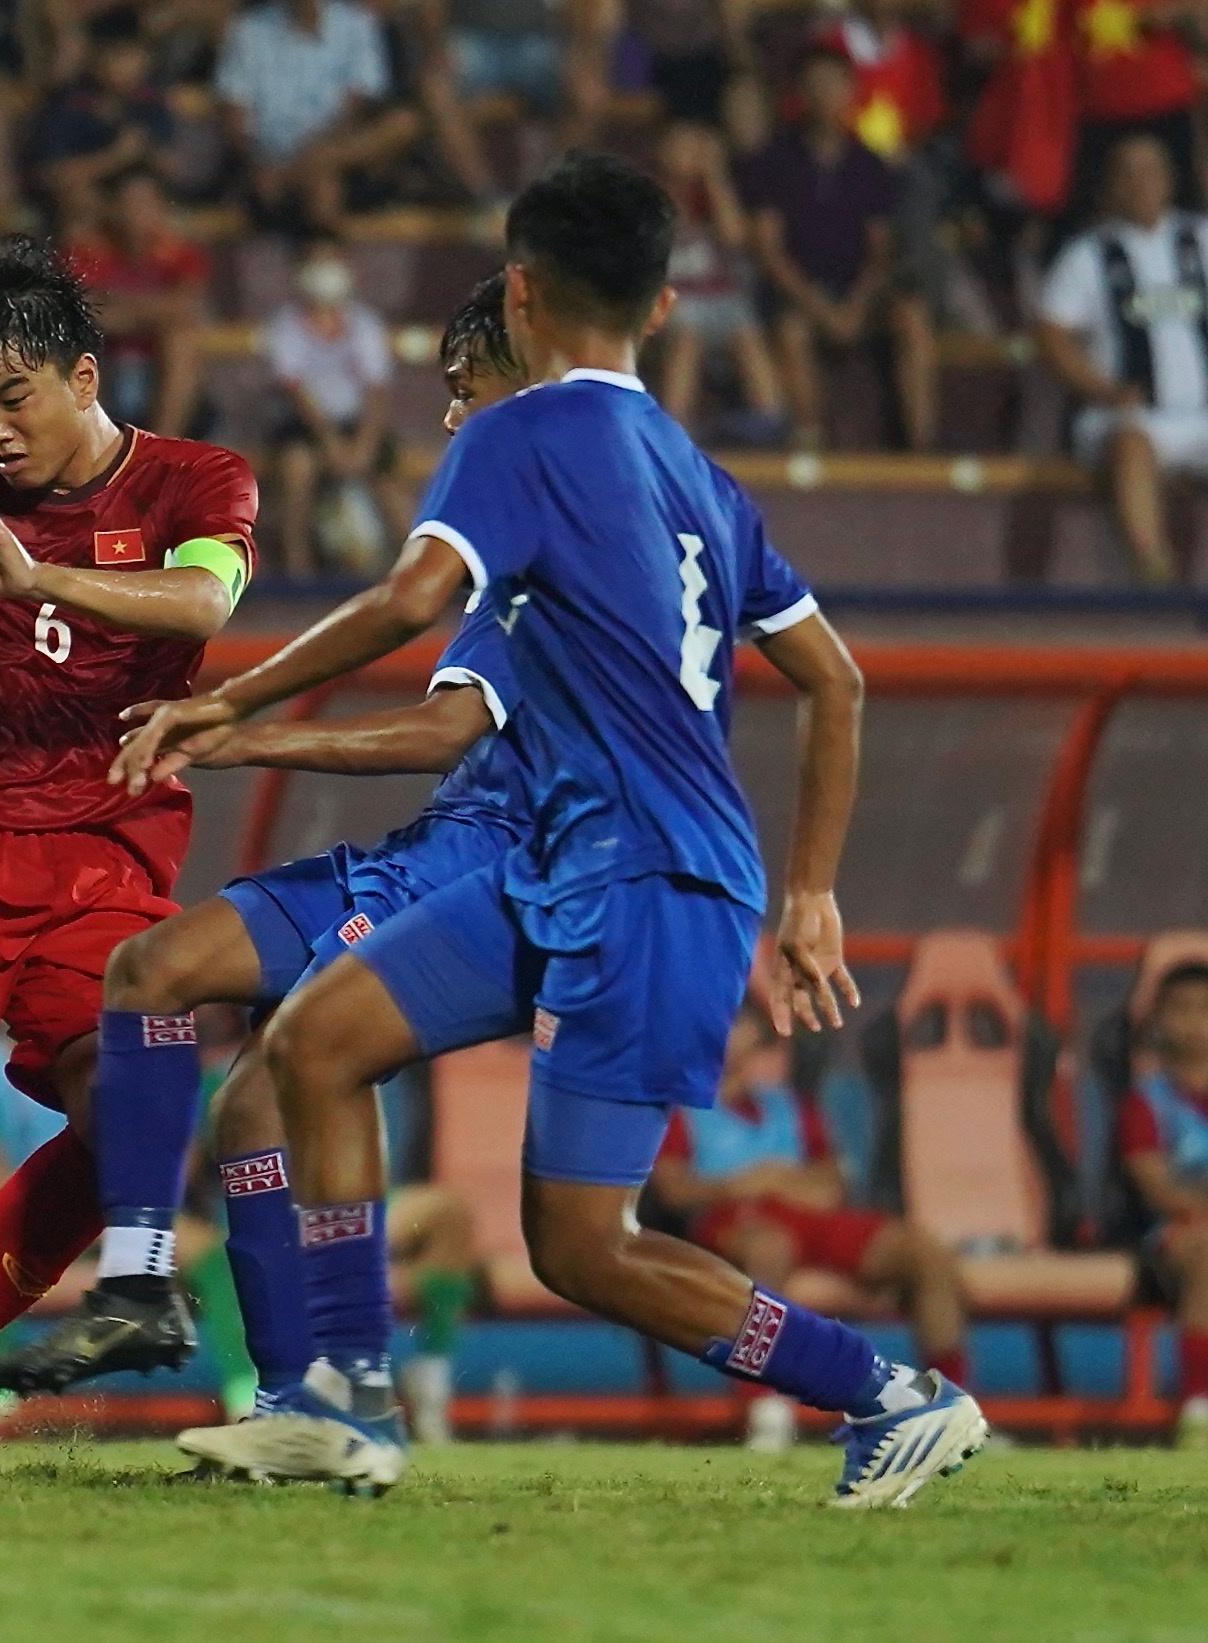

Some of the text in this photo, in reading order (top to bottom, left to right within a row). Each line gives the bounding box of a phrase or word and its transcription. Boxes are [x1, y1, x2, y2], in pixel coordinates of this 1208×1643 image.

[34, 603, 72, 664] 6
[226, 1158, 275, 1177] KTM
[228, 1174, 275, 1194] CTY
[734, 1302, 766, 1360] KTM
[752, 1311, 780, 1365] CTY
